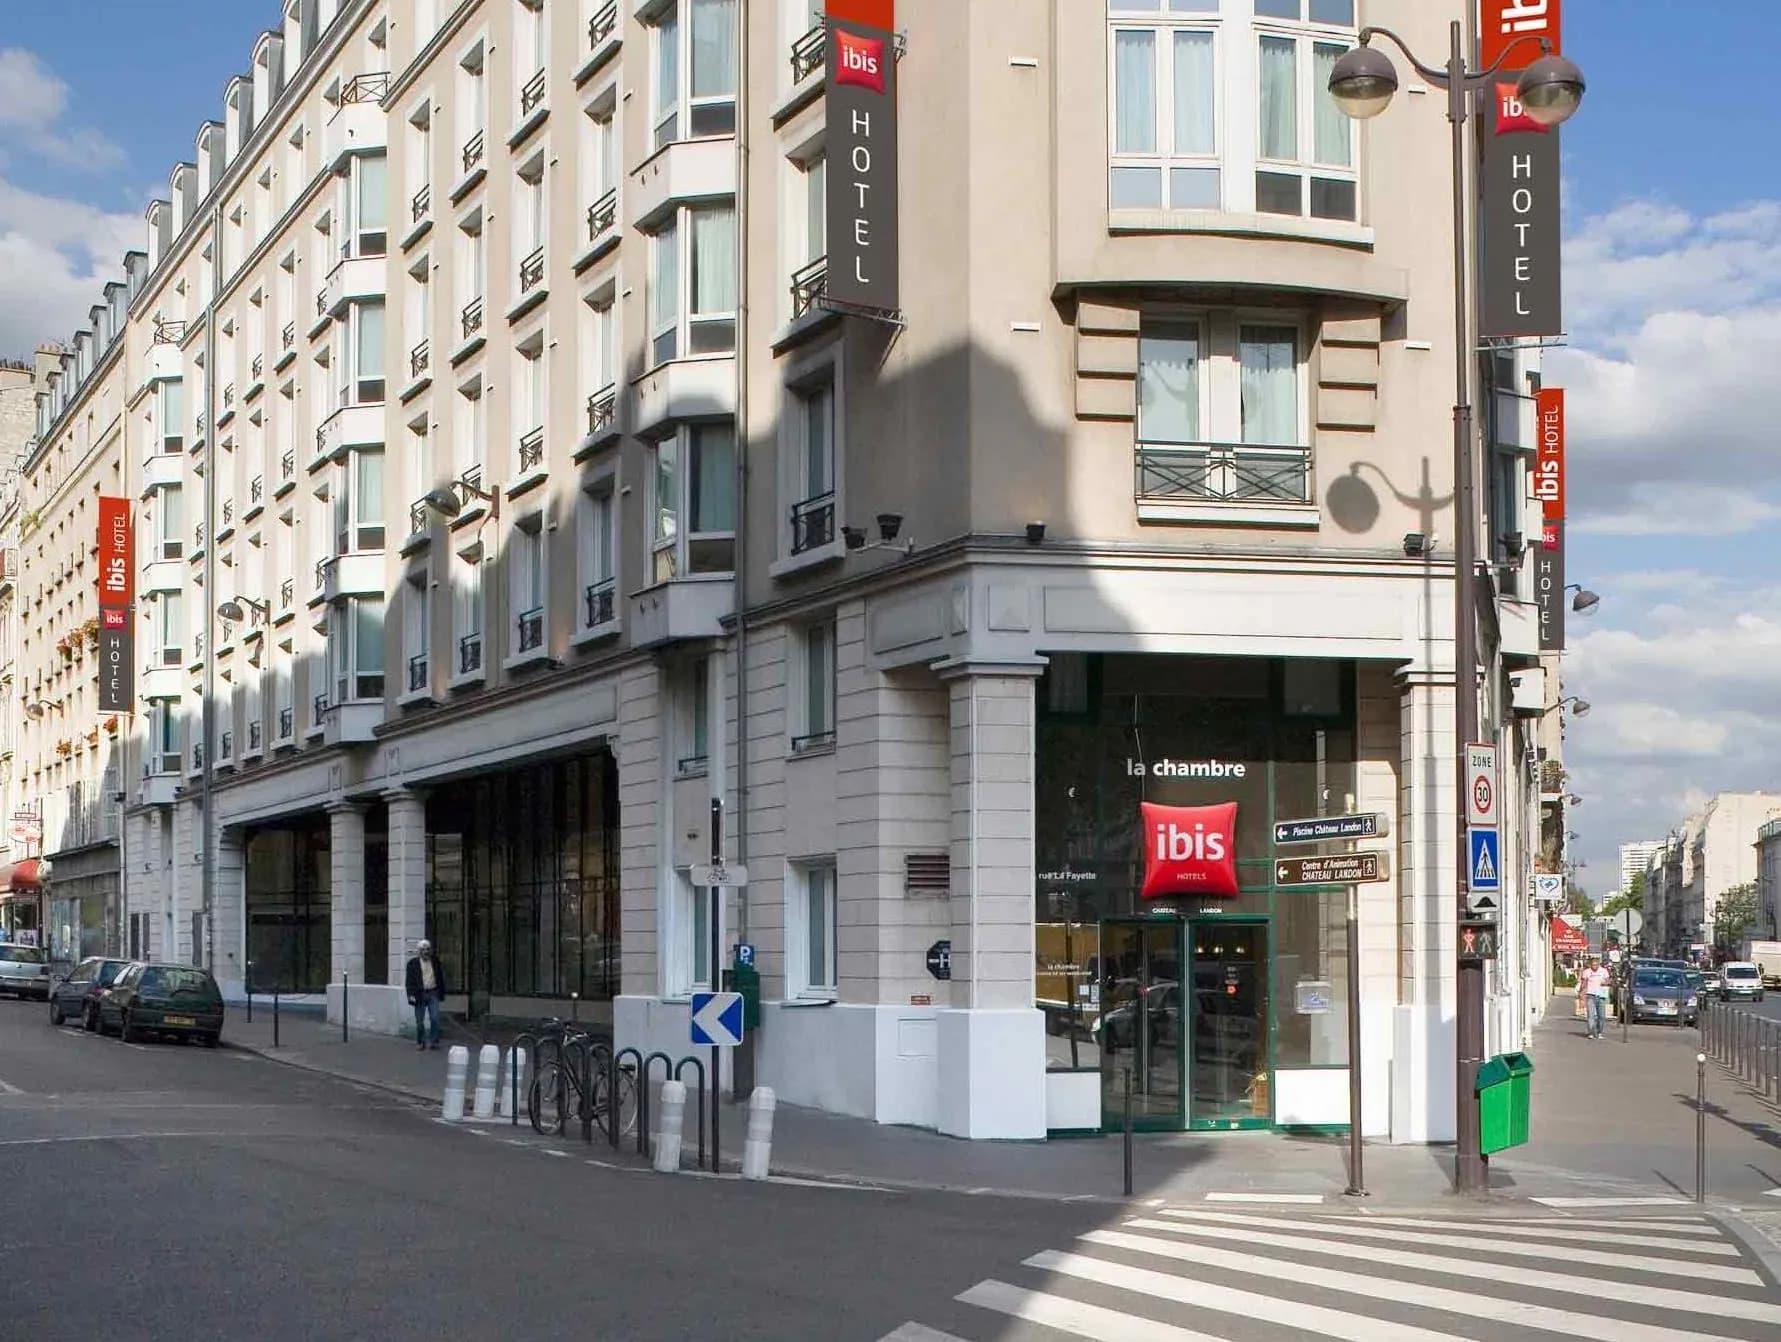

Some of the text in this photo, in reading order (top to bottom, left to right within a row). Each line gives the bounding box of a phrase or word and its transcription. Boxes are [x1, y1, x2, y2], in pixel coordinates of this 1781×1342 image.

[843, 46, 878, 75] ibis
[851, 109, 871, 283] HOTEL
[1512, 154, 1532, 315] HOTEL
[1544, 405, 1559, 454] HOTEL
[106, 512, 126, 591] ibis HOTEL
[1540, 561, 1551, 640] HOTEL
[106, 614, 124, 624] ibis
[110, 638, 120, 703] HOTEL
[1127, 758, 1246, 777] la chambre
[1472, 755, 1492, 767] ZONE
[1478, 786, 1488, 802] 30
[1292, 825, 1313, 837] Piscine
[1340, 821, 1362, 833] Landon
[1157, 824, 1225, 861] ibis
[1176, 872, 1207, 881] HOTELS
[1301, 858, 1359, 871] Centre d'Animation
[1334, 868, 1362, 880] LANDON
